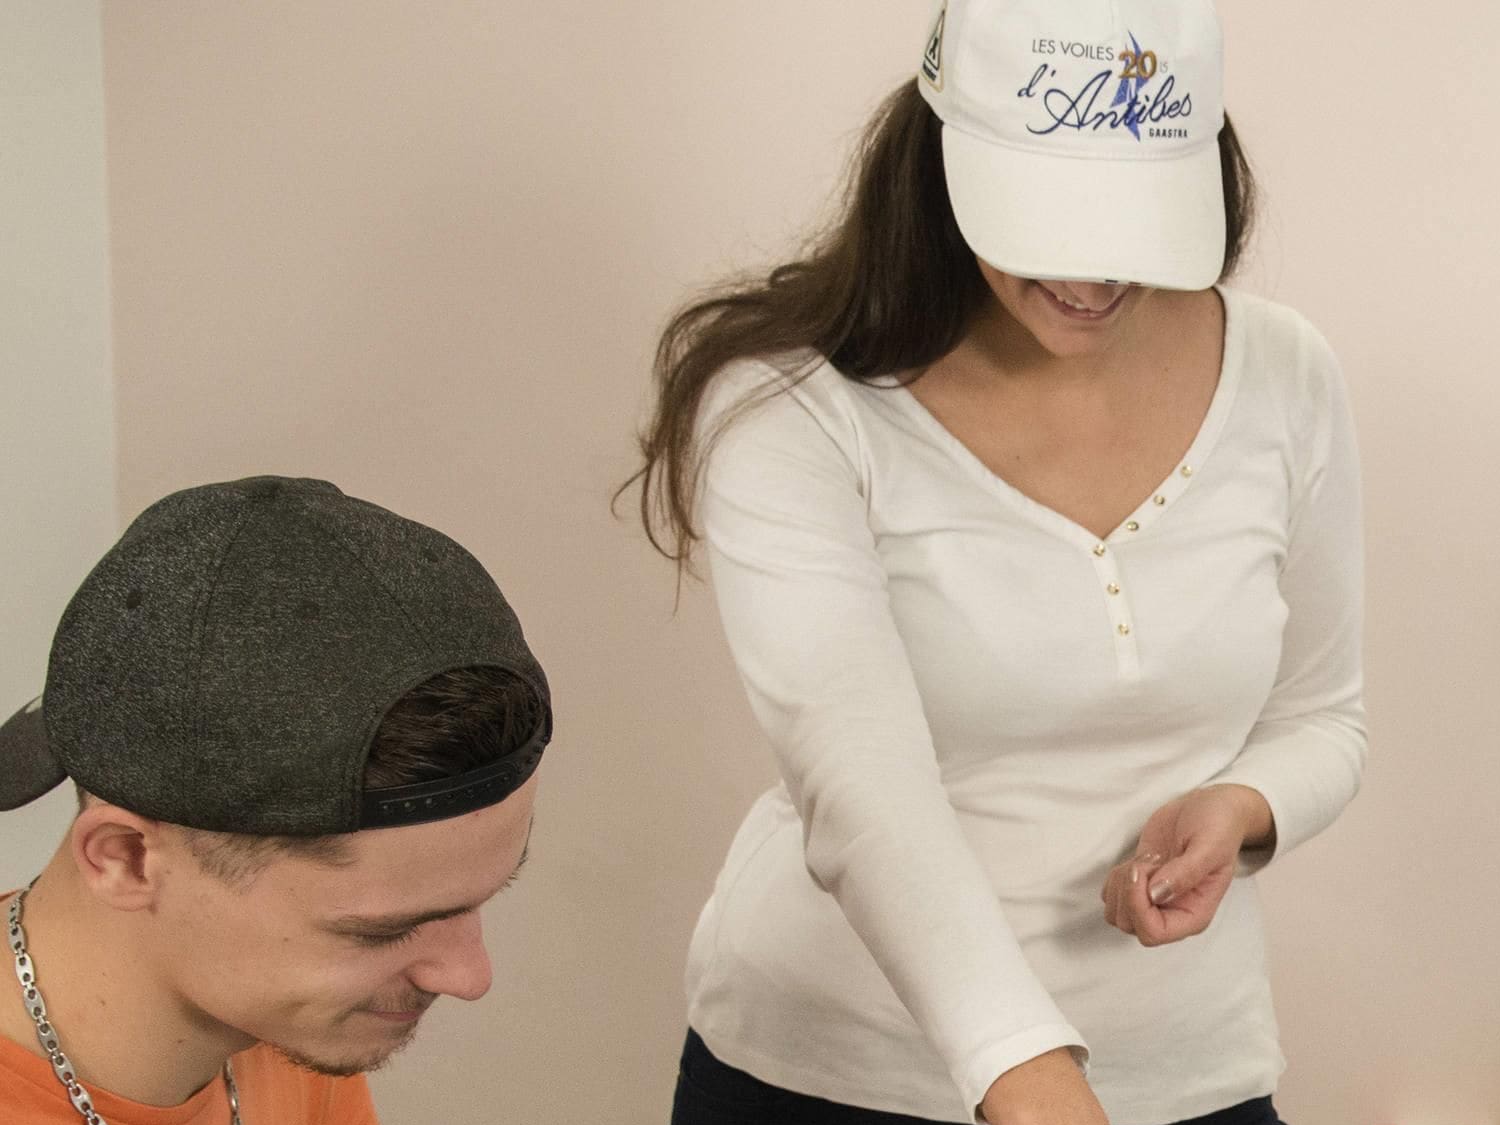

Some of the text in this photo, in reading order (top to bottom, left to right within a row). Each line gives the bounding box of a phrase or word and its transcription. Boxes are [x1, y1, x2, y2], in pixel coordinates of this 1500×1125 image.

[1031, 38, 1114, 62] LES VOILES
[1117, 50, 1157, 80] 20
[1149, 127, 1189, 139] GAASTRA
